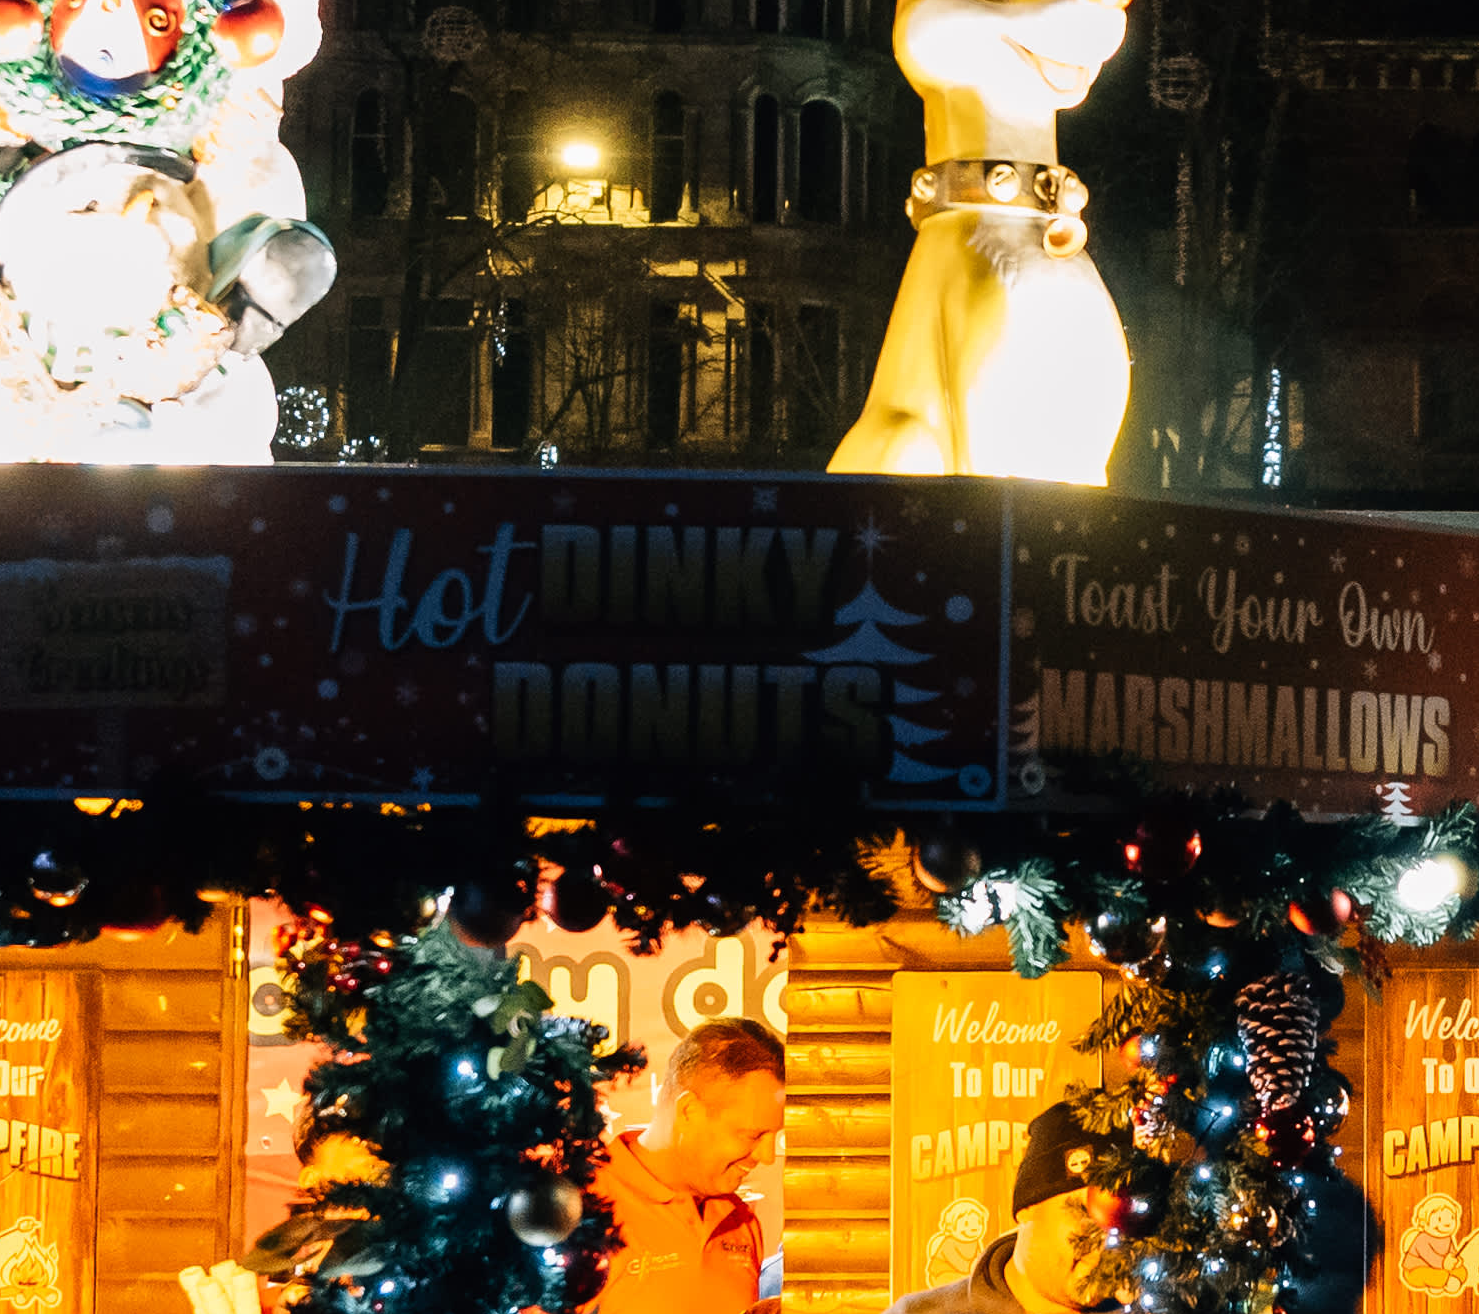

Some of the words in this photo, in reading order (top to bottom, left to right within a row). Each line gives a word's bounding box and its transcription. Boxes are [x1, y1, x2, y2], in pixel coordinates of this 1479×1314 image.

[325, 522, 536, 654] Hot
[539, 524, 840, 628] DINKY
[1050, 552, 1181, 635] Toast
[1197, 566, 1323, 654] Your
[1339, 580, 1436, 656] Own
[492, 661, 889, 767] DONUTS
[1039, 668, 1450, 777] MARSHMALLOWS
[932, 1001, 1062, 1046] Welcome
[950, 1061, 984, 1098] To
[991, 1061, 1045, 1098] Our
[1423, 1057, 1455, 1095] To
[911, 1120, 1029, 1182] CAMPF
